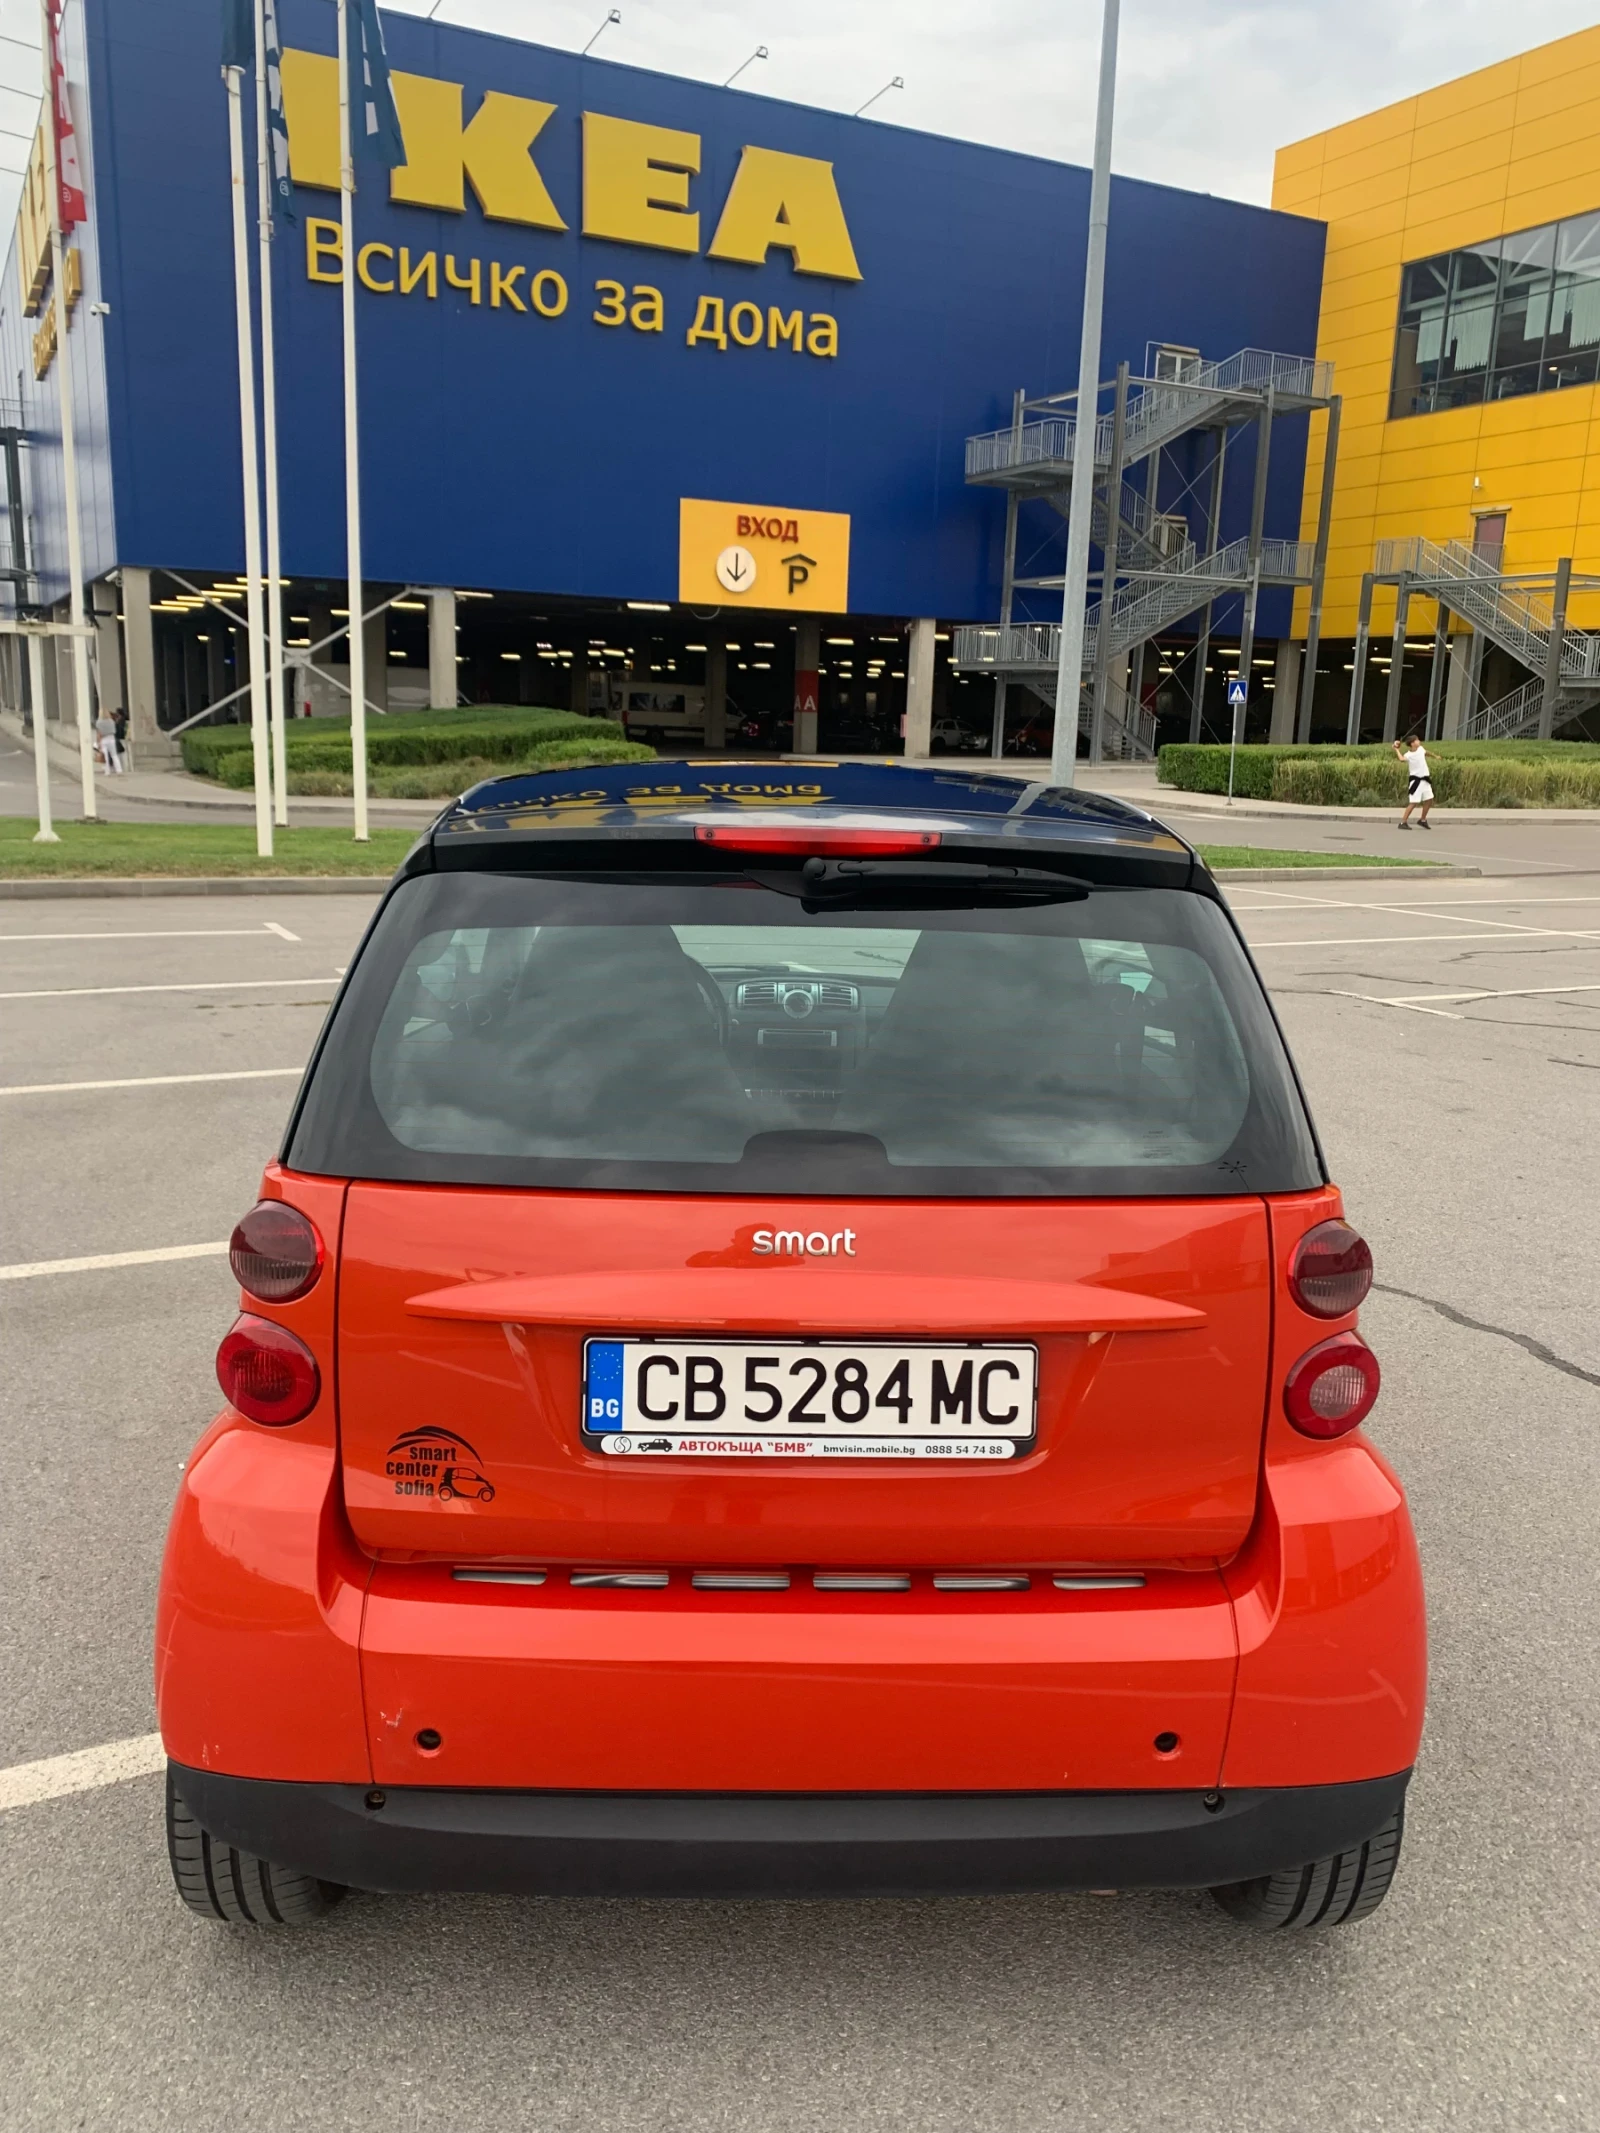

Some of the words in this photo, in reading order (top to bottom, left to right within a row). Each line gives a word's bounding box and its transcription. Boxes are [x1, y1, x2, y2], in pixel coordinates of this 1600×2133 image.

[278, 47, 864, 281] IKEA
[306, 216, 569, 317] Всичко
[593, 279, 664, 332] за
[686, 295, 838, 357] дома
[737, 514, 799, 543] ВХОД
[752, 1228, 857, 1256] smart
[637, 1355, 726, 1421] CB
[744, 1357, 913, 1423] 5284
[930, 1359, 1020, 1424] MC
[591, 1398, 620, 1418] BG
[409, 1447, 457, 1461] smart
[678, 1441, 763, 1454] АВТОКЪЩА
[823, 1445, 916, 1455] bmvisin.mobile.bg
[925, 1445, 952, 1454] 0888
[955, 1445, 969, 1454] 54
[973, 1445, 986, 1454] 74
[989, 1445, 1003, 1455] 88
[386, 1461, 438, 1477] center
[395, 1480, 434, 1496] sofia
